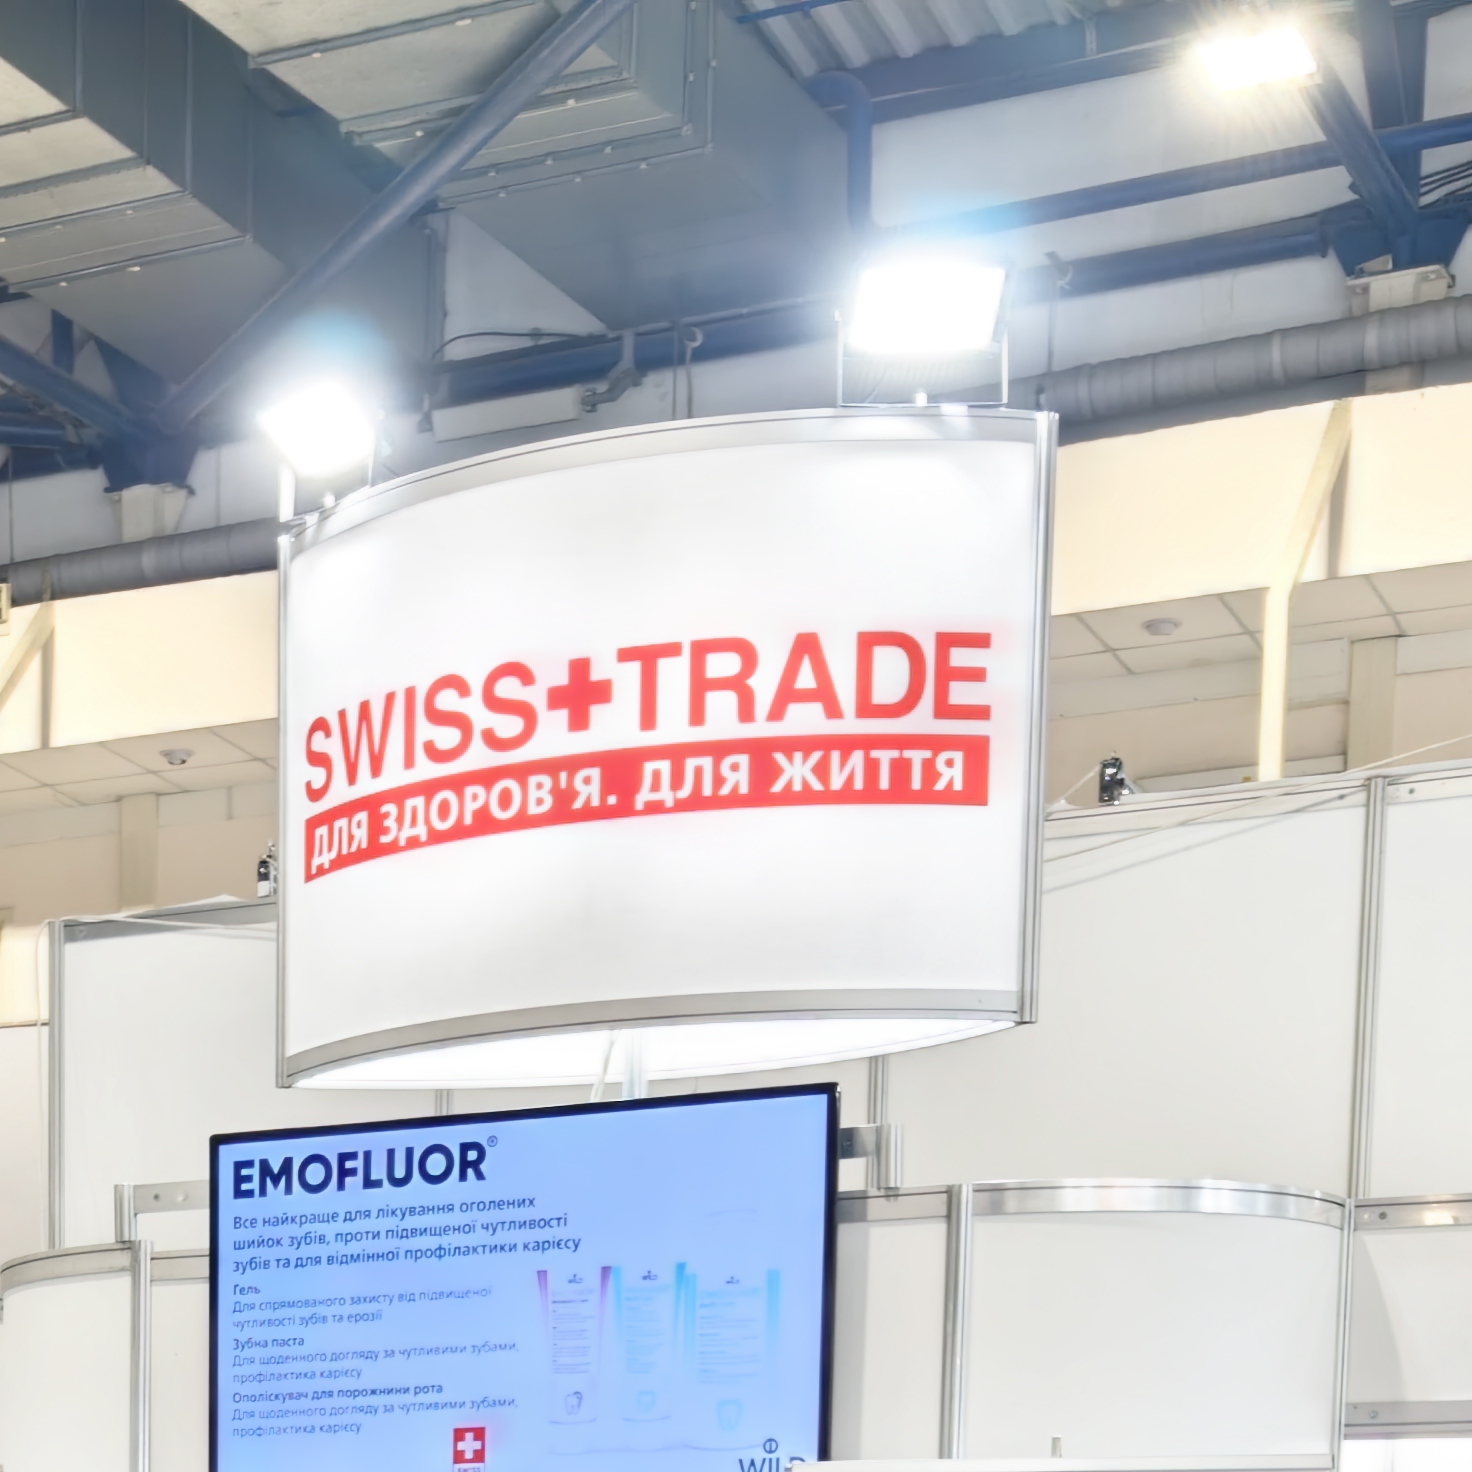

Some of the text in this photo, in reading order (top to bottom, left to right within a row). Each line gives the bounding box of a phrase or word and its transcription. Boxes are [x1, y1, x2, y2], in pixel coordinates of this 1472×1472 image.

[304, 631, 992, 803] SWISS+TRADE
[311, 748, 965, 875] ДЛЯ ЗДОРОВ'Я. ДЛЯ ЖИТТЯ
[233, 1196, 536, 1230] Все найкраще для лікування оголених
[233, 1214, 568, 1252] шийок зубів, проти підвищеної чутливості
[233, 1234, 581, 1274] зубів та для відмінної профілактики карієсу
[232, 1301, 256, 1314] Для
[259, 1296, 347, 1312] спрямованого
[349, 1293, 394, 1307] захисту
[398, 1291, 417, 1303] від
[233, 1316, 296, 1331] чутливості
[331, 1313, 344, 1324] та
[233, 1337, 305, 1351] Зубна паста
[232, 1355, 256, 1368] Для
[259, 1352, 327, 1366] щоденного
[329, 1348, 380, 1363] догляду
[233, 1369, 316, 1384] профілактика
[233, 1383, 443, 1404] Ополіскувач для порожнини рота
[232, 1408, 256, 1421] Для
[259, 1405, 327, 1420] щоденного
[329, 1402, 379, 1416] догляду
[233, 1423, 316, 1437] профілактика
